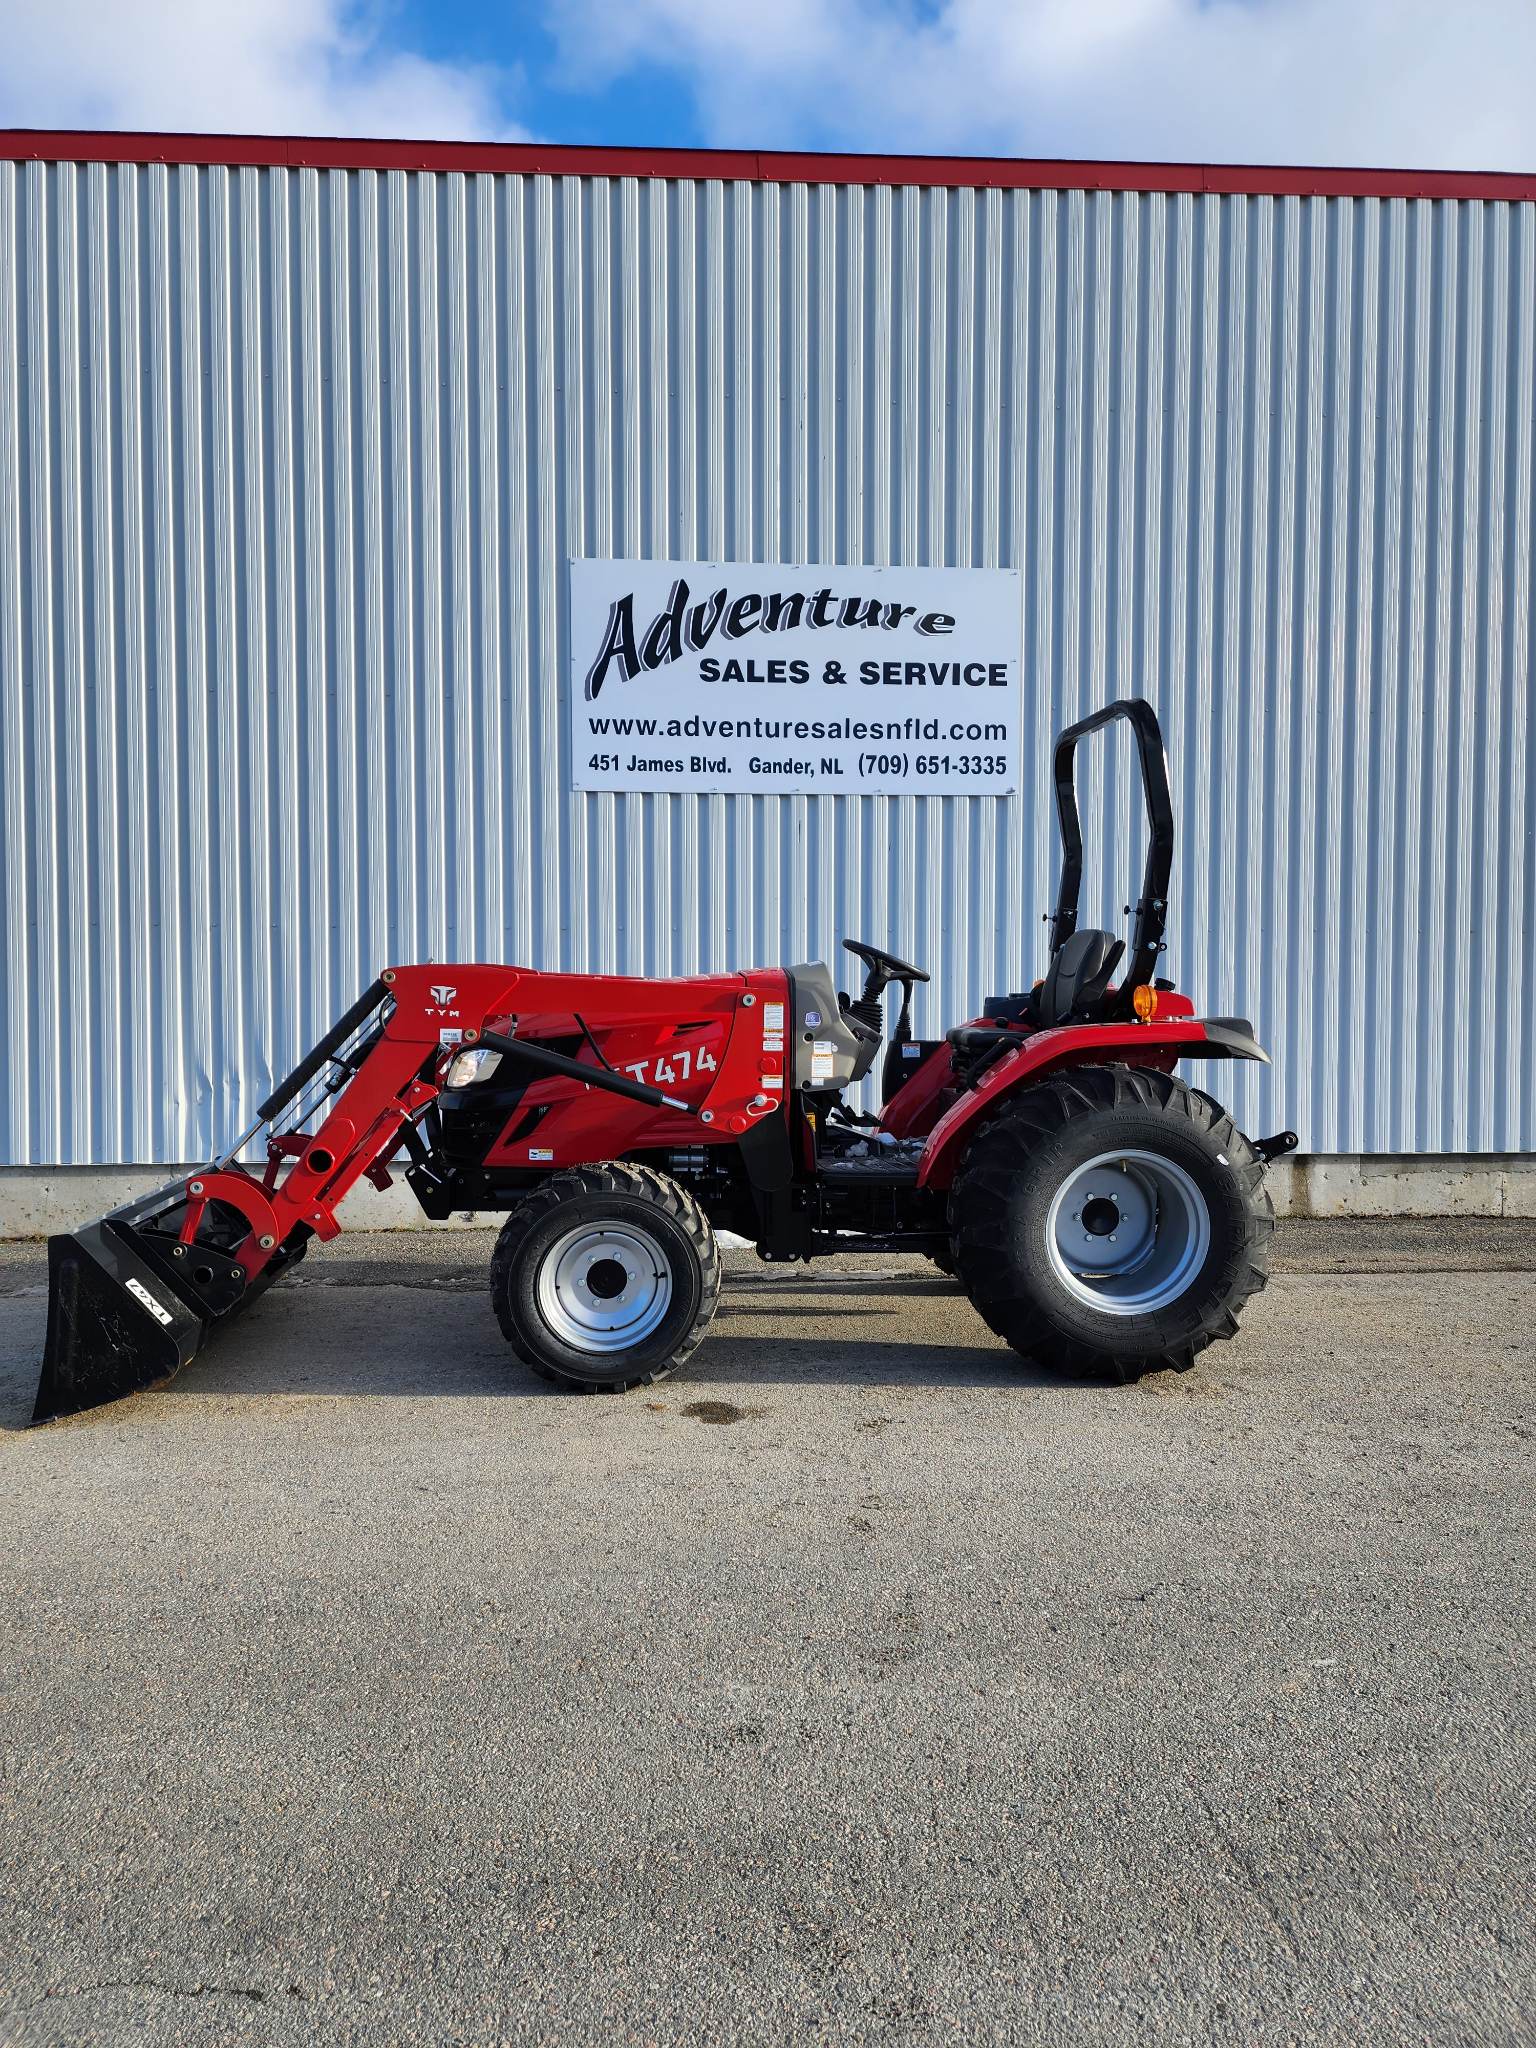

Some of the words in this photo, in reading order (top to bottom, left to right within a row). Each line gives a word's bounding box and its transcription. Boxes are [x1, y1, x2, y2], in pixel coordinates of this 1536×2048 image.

[585, 578, 956, 701] Adventure
[699, 657, 810, 684] SALES
[822, 660, 848, 685] &
[859, 661, 1008, 687] SERVICE
[588, 714, 1007, 741] www.adventuresalesnfld.com
[588, 753, 620, 772] 451
[626, 754, 684, 773] James
[690, 755, 732, 774] Blvd.
[748, 756, 815, 778] Gander,
[820, 757, 844, 775] NL
[858, 752, 909, 778] (709)
[915, 754, 1007, 775] 651-3335
[424, 1008, 460, 1018] TYM
